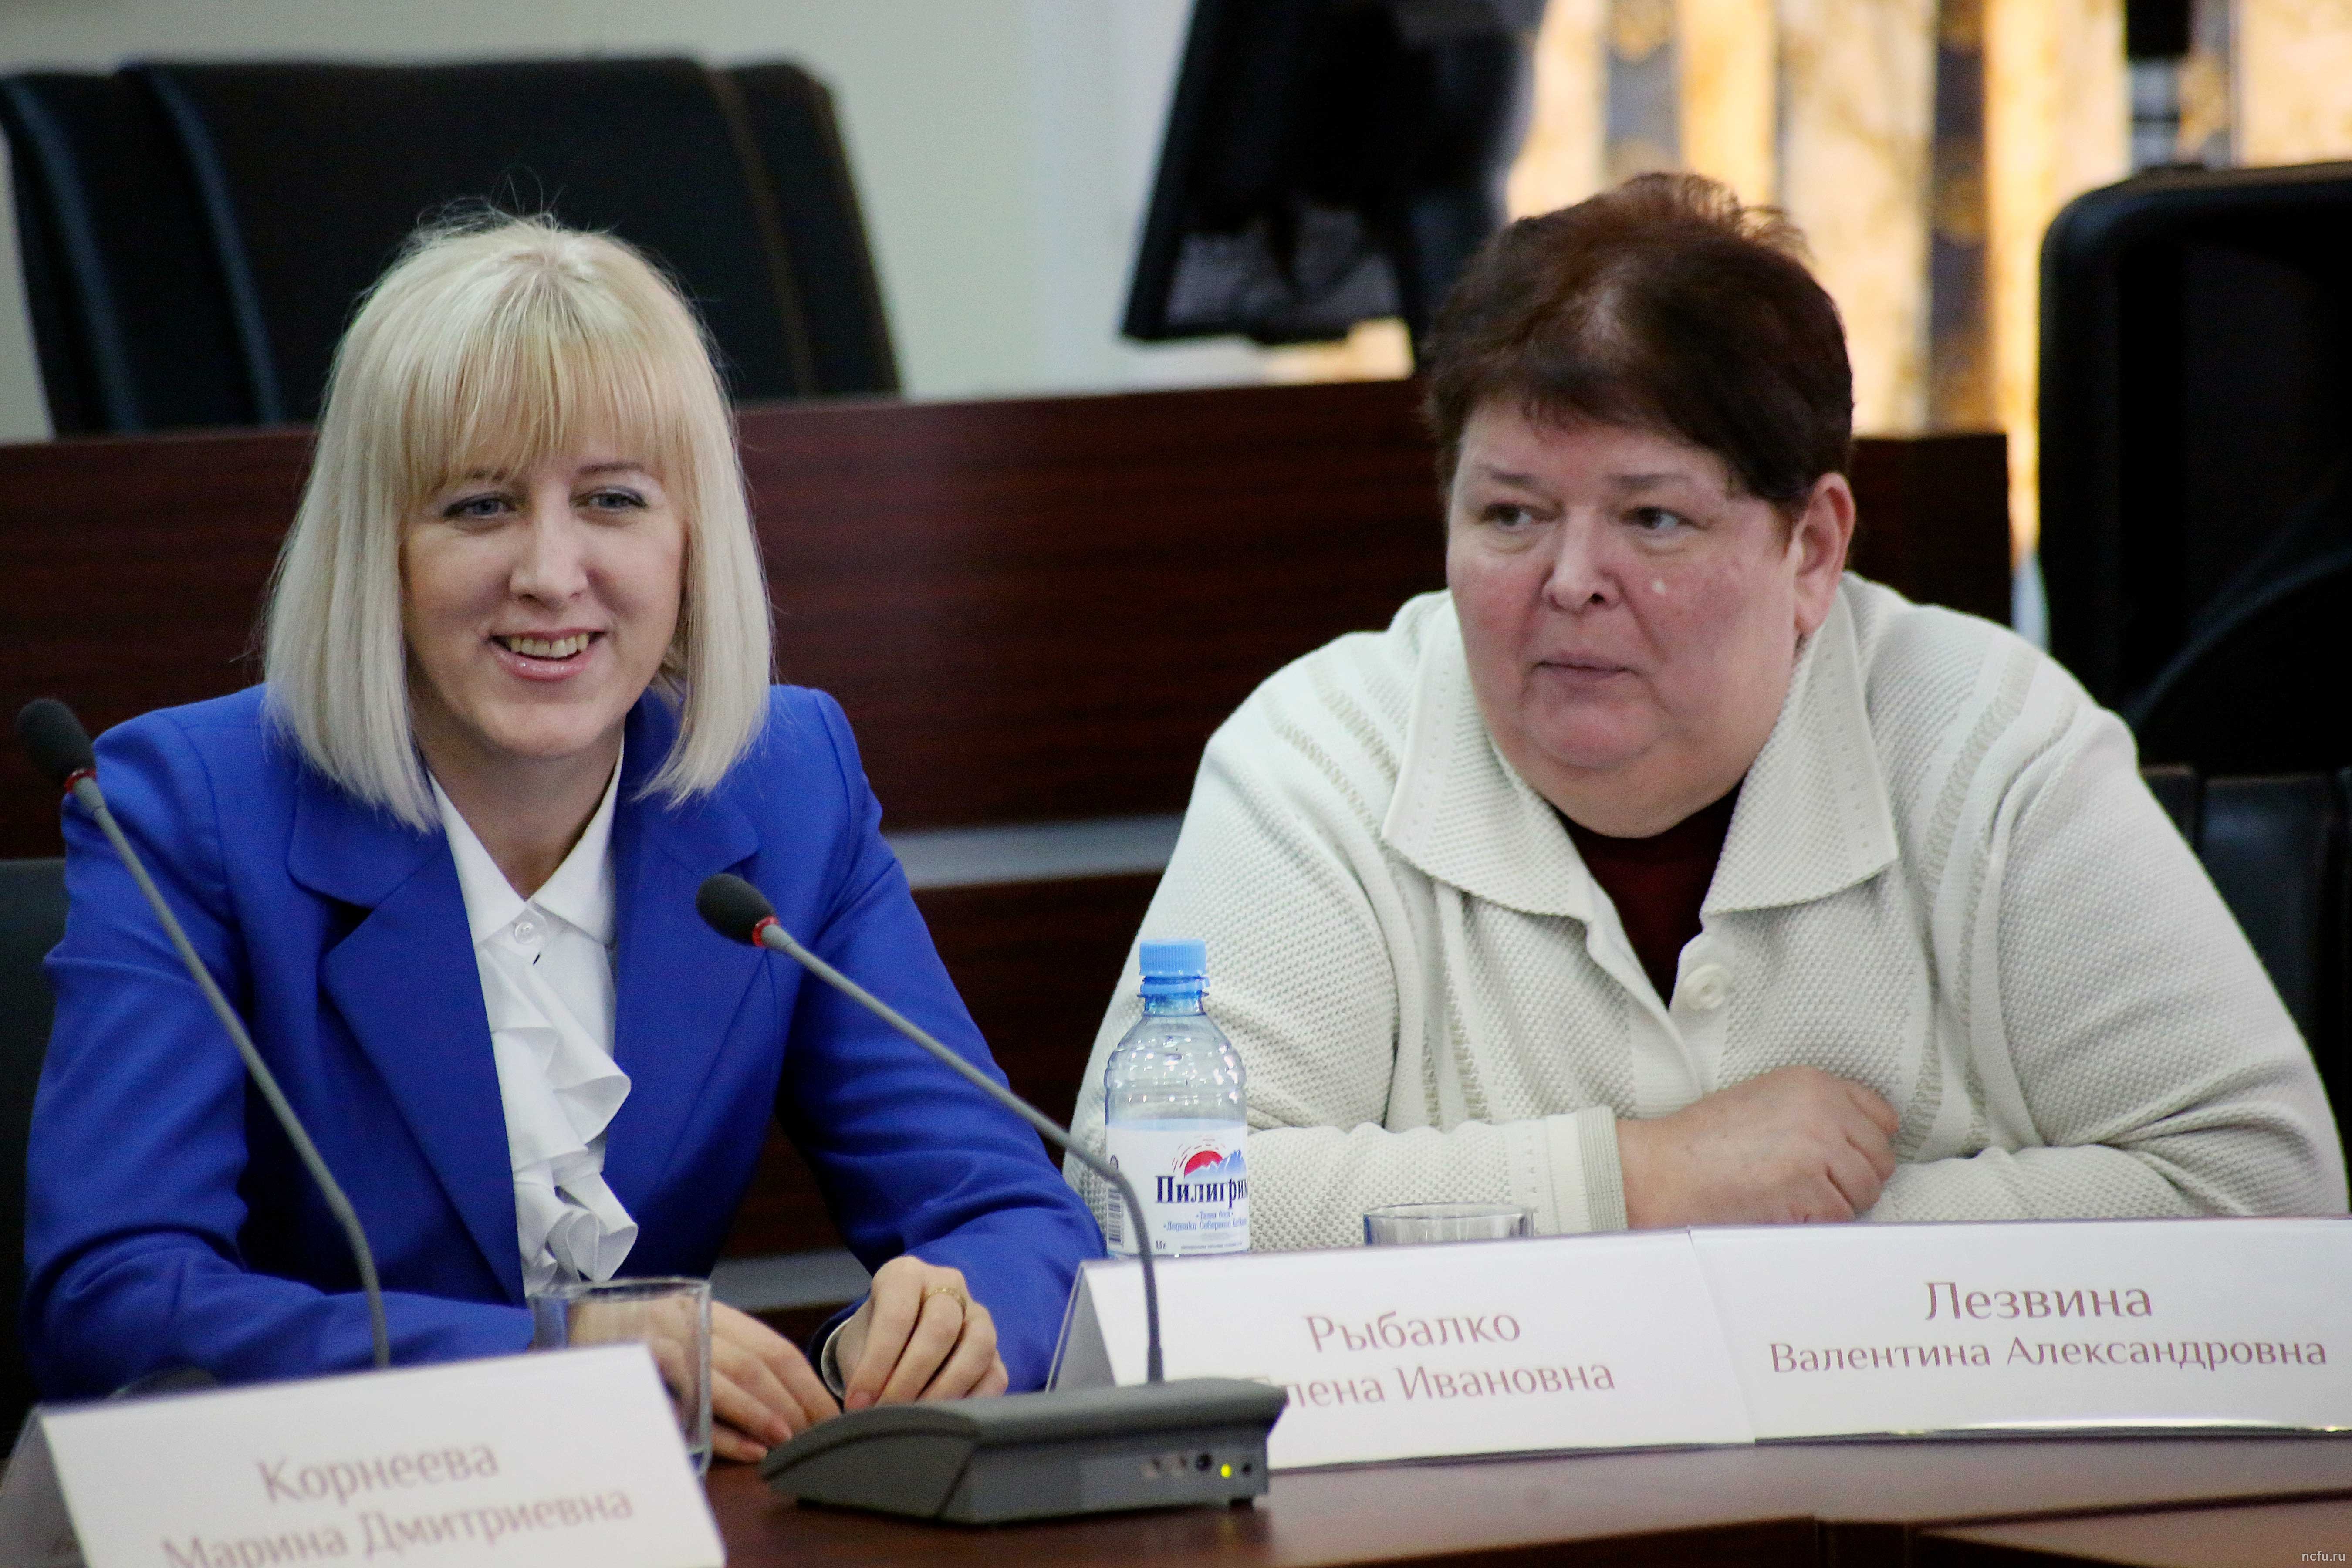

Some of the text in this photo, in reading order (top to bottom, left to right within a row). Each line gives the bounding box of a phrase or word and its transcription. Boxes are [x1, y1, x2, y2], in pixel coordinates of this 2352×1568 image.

[1925, 1281, 2153, 1321] Лезвина
[1304, 1310, 1521, 1353] Рыбалко
[1768, 1335, 2327, 1373] Валентина Александровна
[1259, 1362, 1615, 1408] лена Ивановна
[255, 1443, 500, 1506] Корнеева
[160, 1490, 635, 1568] Марина Дмитриевна
